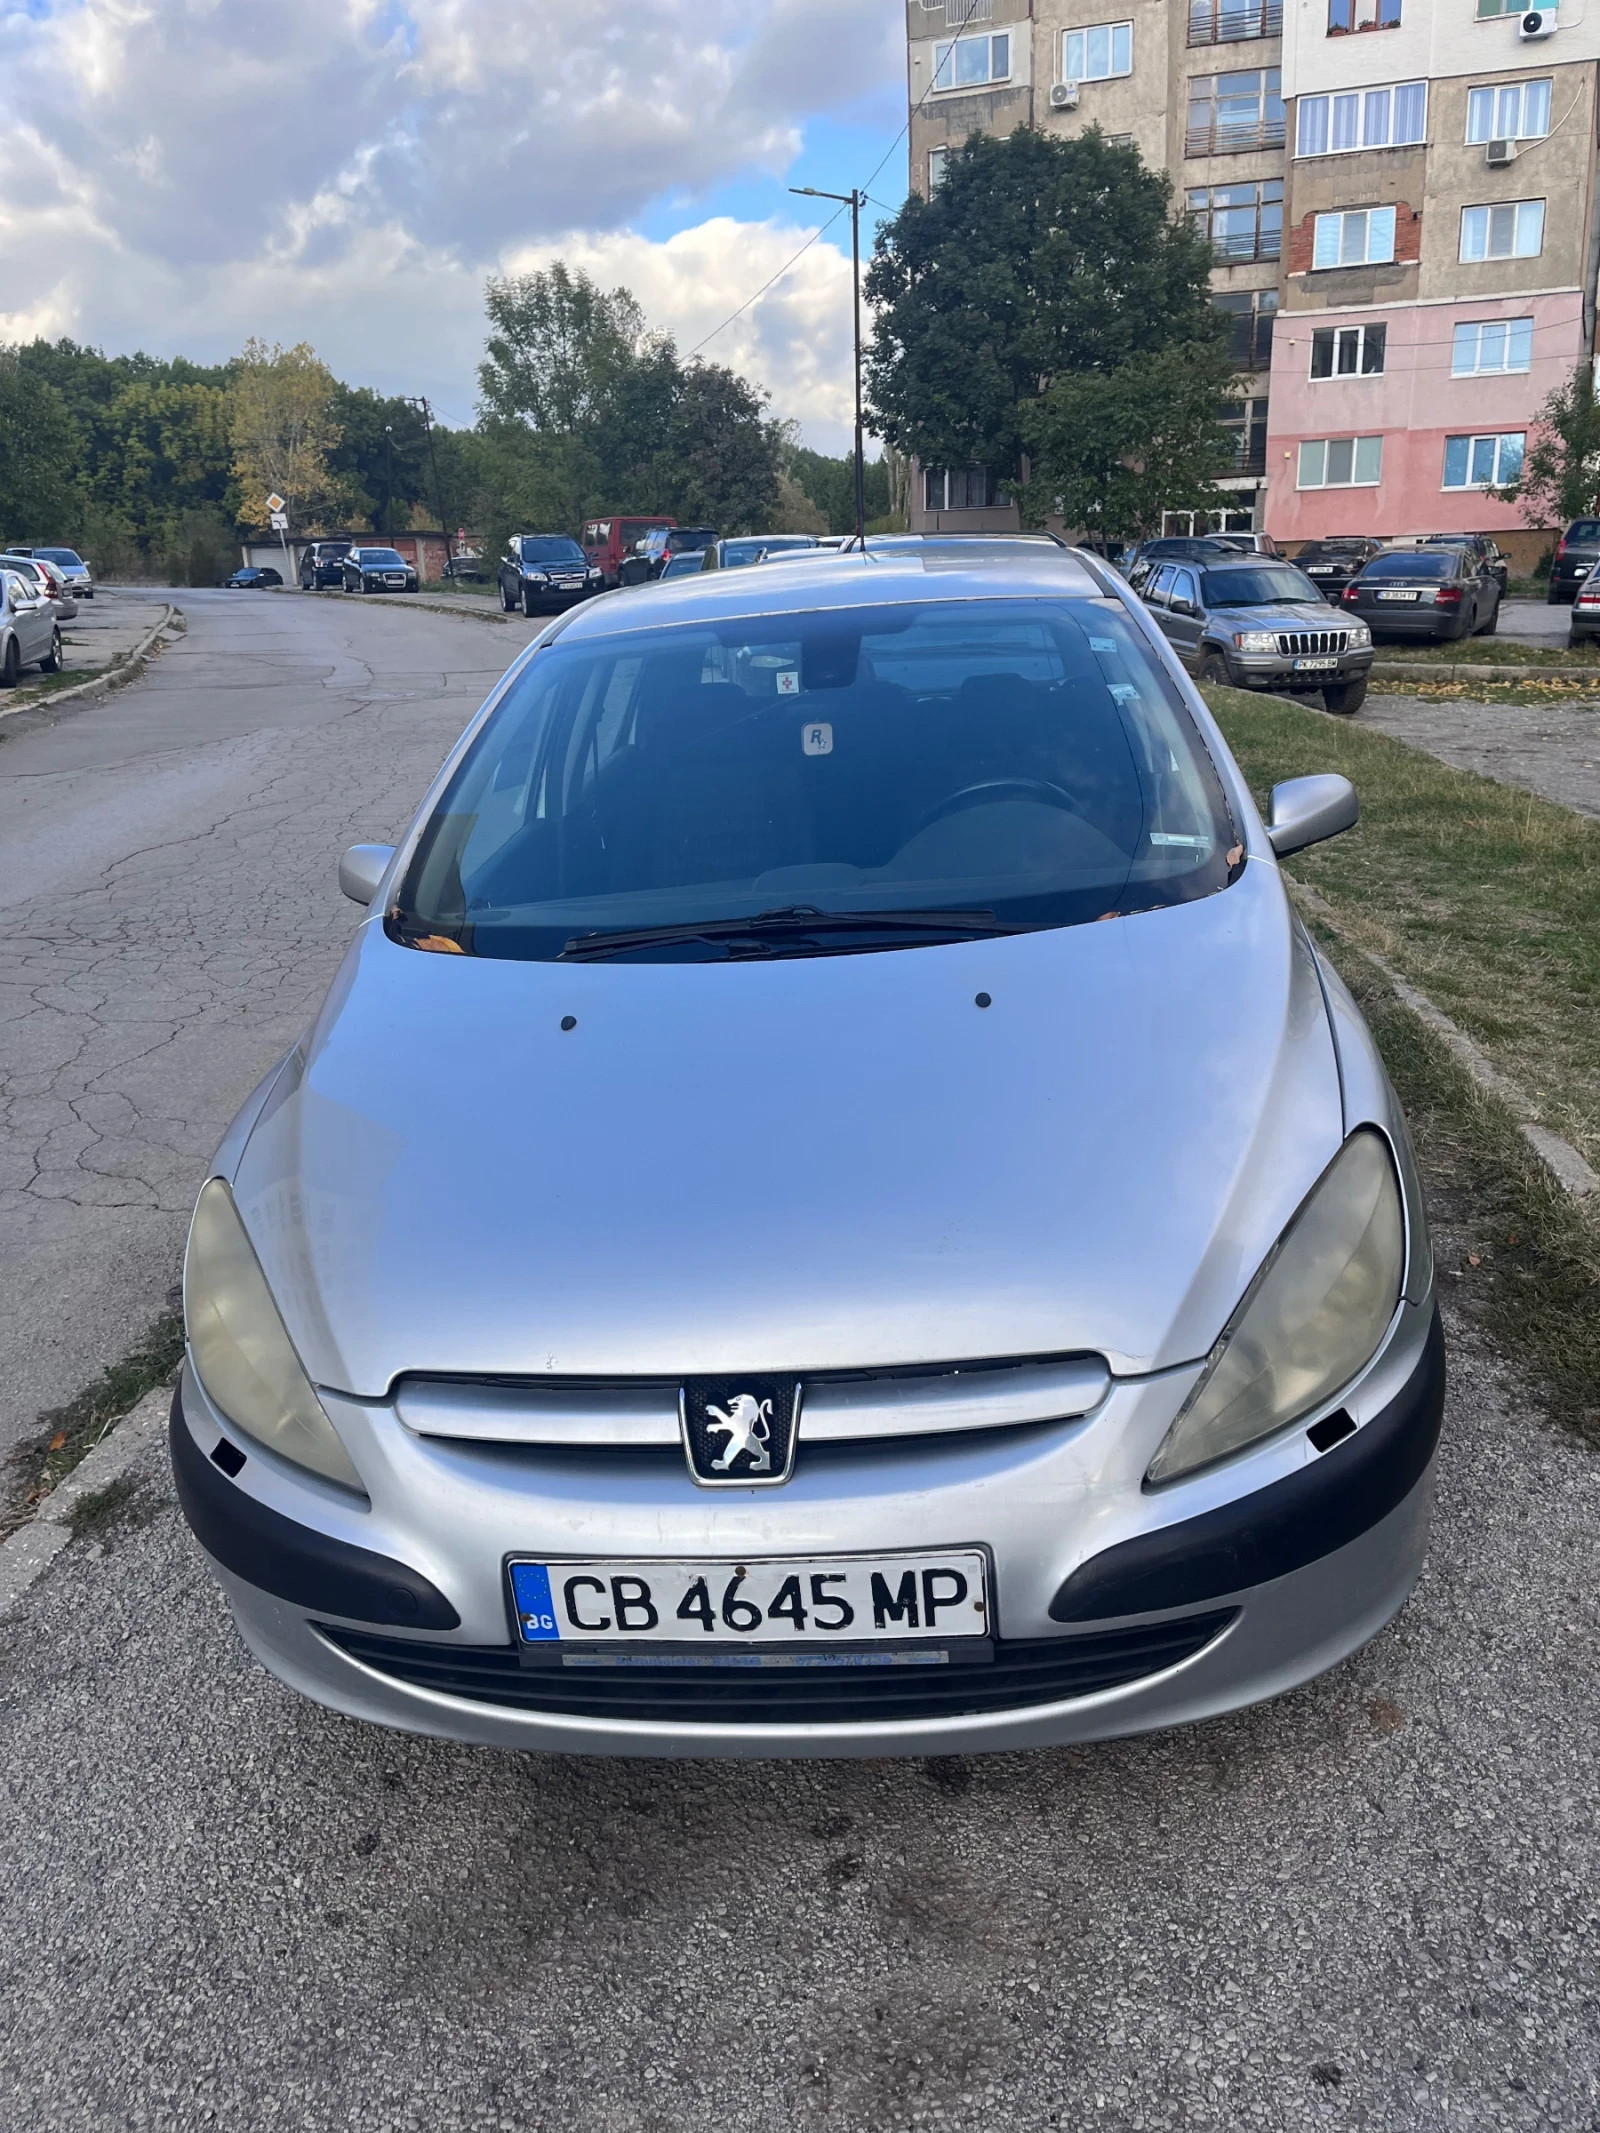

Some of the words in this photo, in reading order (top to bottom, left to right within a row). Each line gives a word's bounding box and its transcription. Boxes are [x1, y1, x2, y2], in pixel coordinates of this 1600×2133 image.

[1298, 660, 1309, 669] PK
[1309, 659, 1327, 668] 7295
[525, 1613, 553, 1630] BG
[563, 1573, 659, 1631] CB
[676, 1571, 854, 1632] 4645
[871, 1568, 969, 1629] MP
